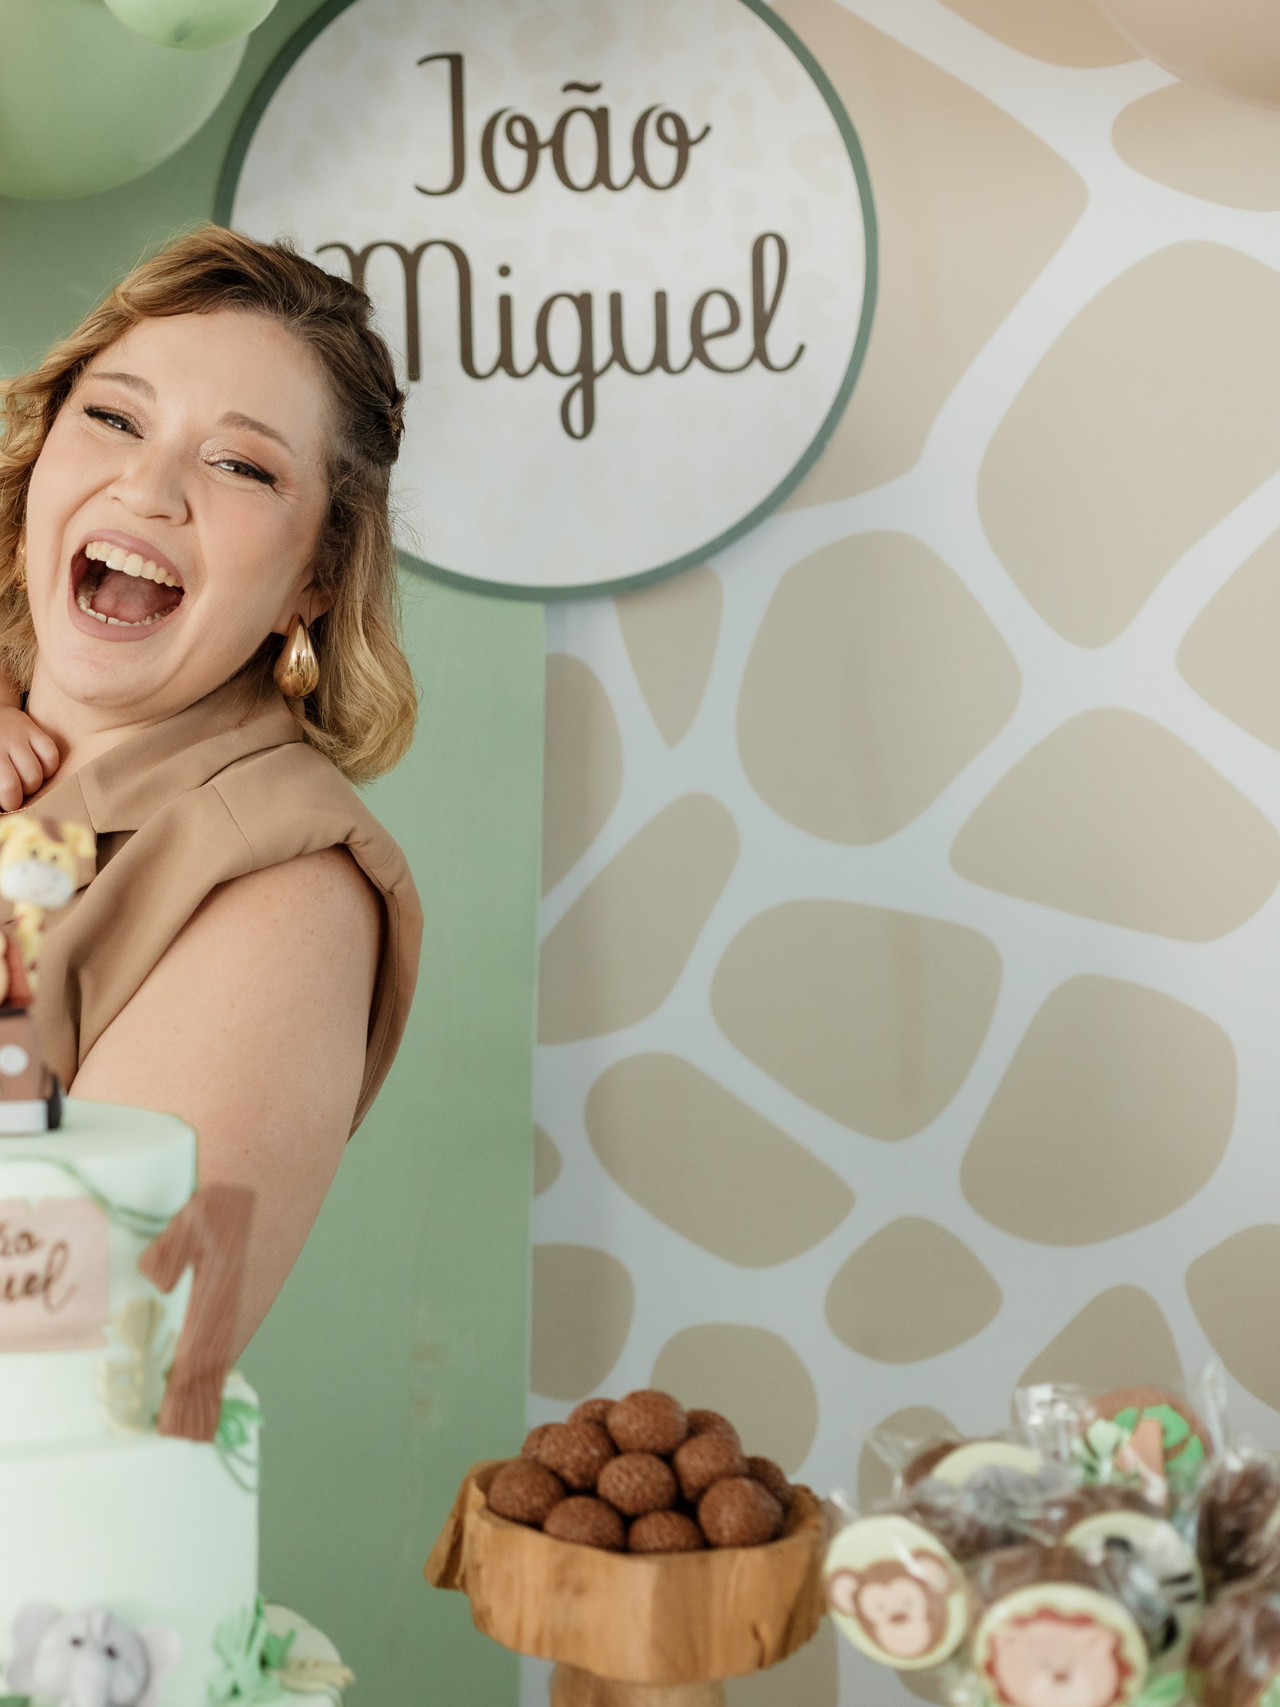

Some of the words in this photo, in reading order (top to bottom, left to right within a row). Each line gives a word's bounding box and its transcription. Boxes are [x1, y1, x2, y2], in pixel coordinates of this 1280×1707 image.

[414, 51, 712, 196] João
[315, 231, 806, 440] Miguel
[138, 1184, 256, 1443] 1
